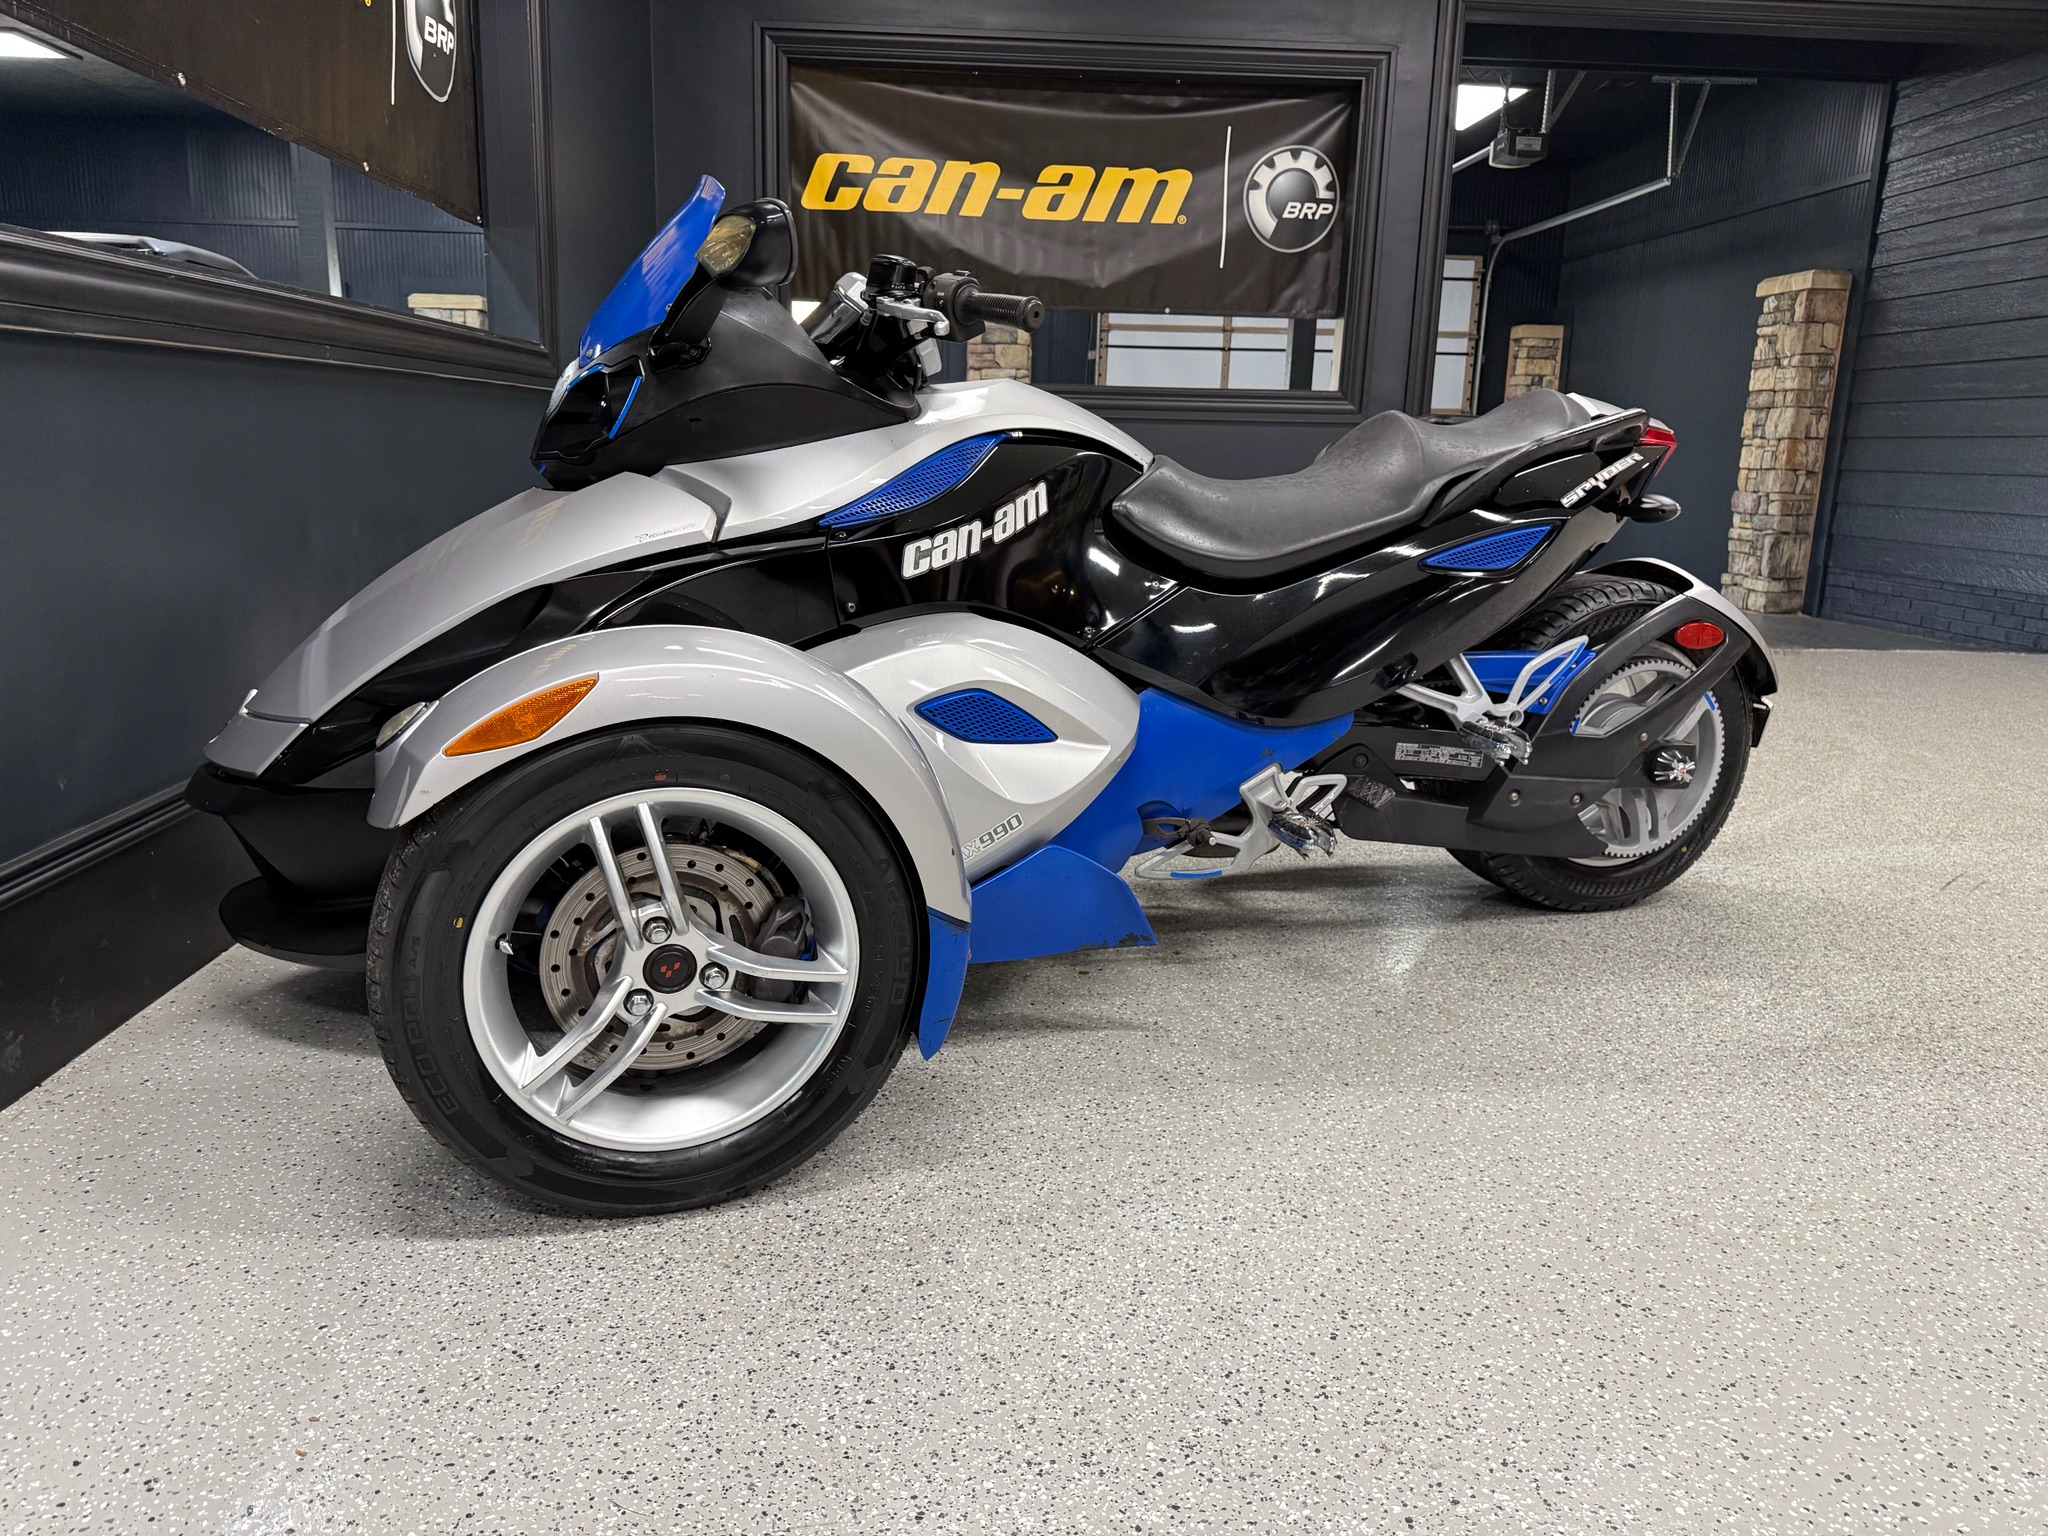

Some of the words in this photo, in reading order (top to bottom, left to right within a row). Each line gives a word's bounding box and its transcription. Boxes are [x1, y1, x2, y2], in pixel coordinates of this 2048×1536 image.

[424, 15, 454, 55] BRP
[1282, 202, 1334, 220] BRP
[1560, 453, 1643, 508] SPYDER
[902, 480, 1049, 580] can-am
[402, 973, 426, 1045] PRO
[415, 1052, 460, 1115] ECO
